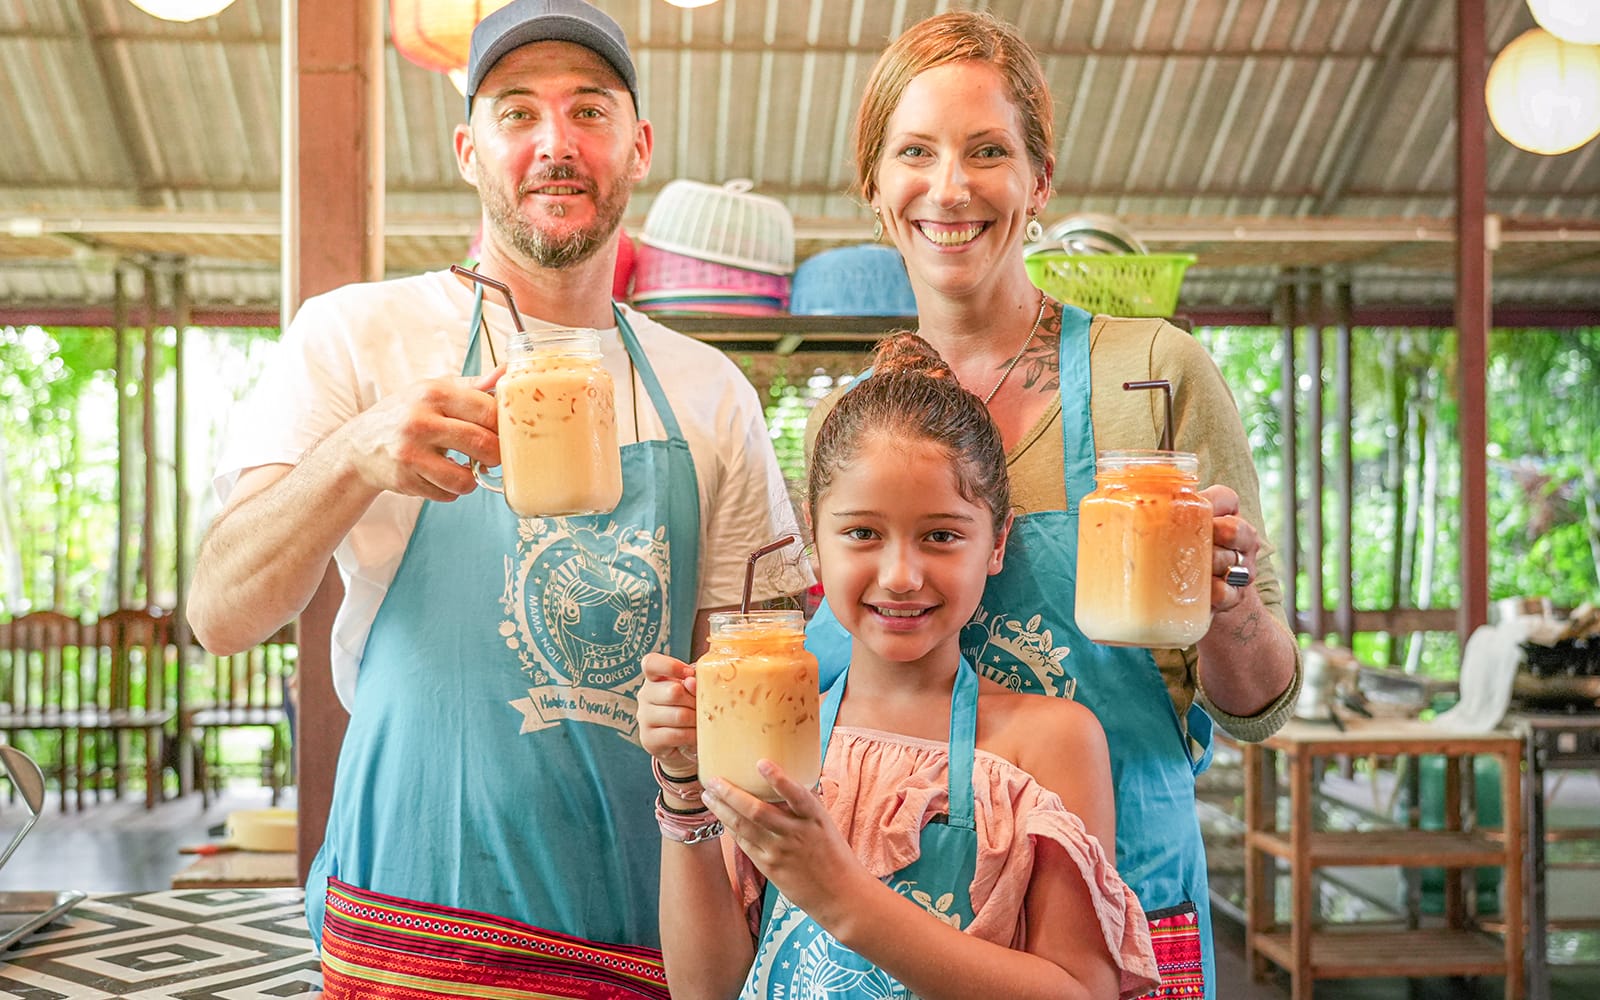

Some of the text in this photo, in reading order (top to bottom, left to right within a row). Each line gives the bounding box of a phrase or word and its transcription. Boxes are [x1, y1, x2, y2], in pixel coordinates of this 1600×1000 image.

[529, 594, 543, 634] MAMA
[587, 662, 636, 684] COOKERY
[636, 620, 659, 662] SCHOOL
[569, 699, 577, 709] &
[579, 694, 612, 715] Organic
